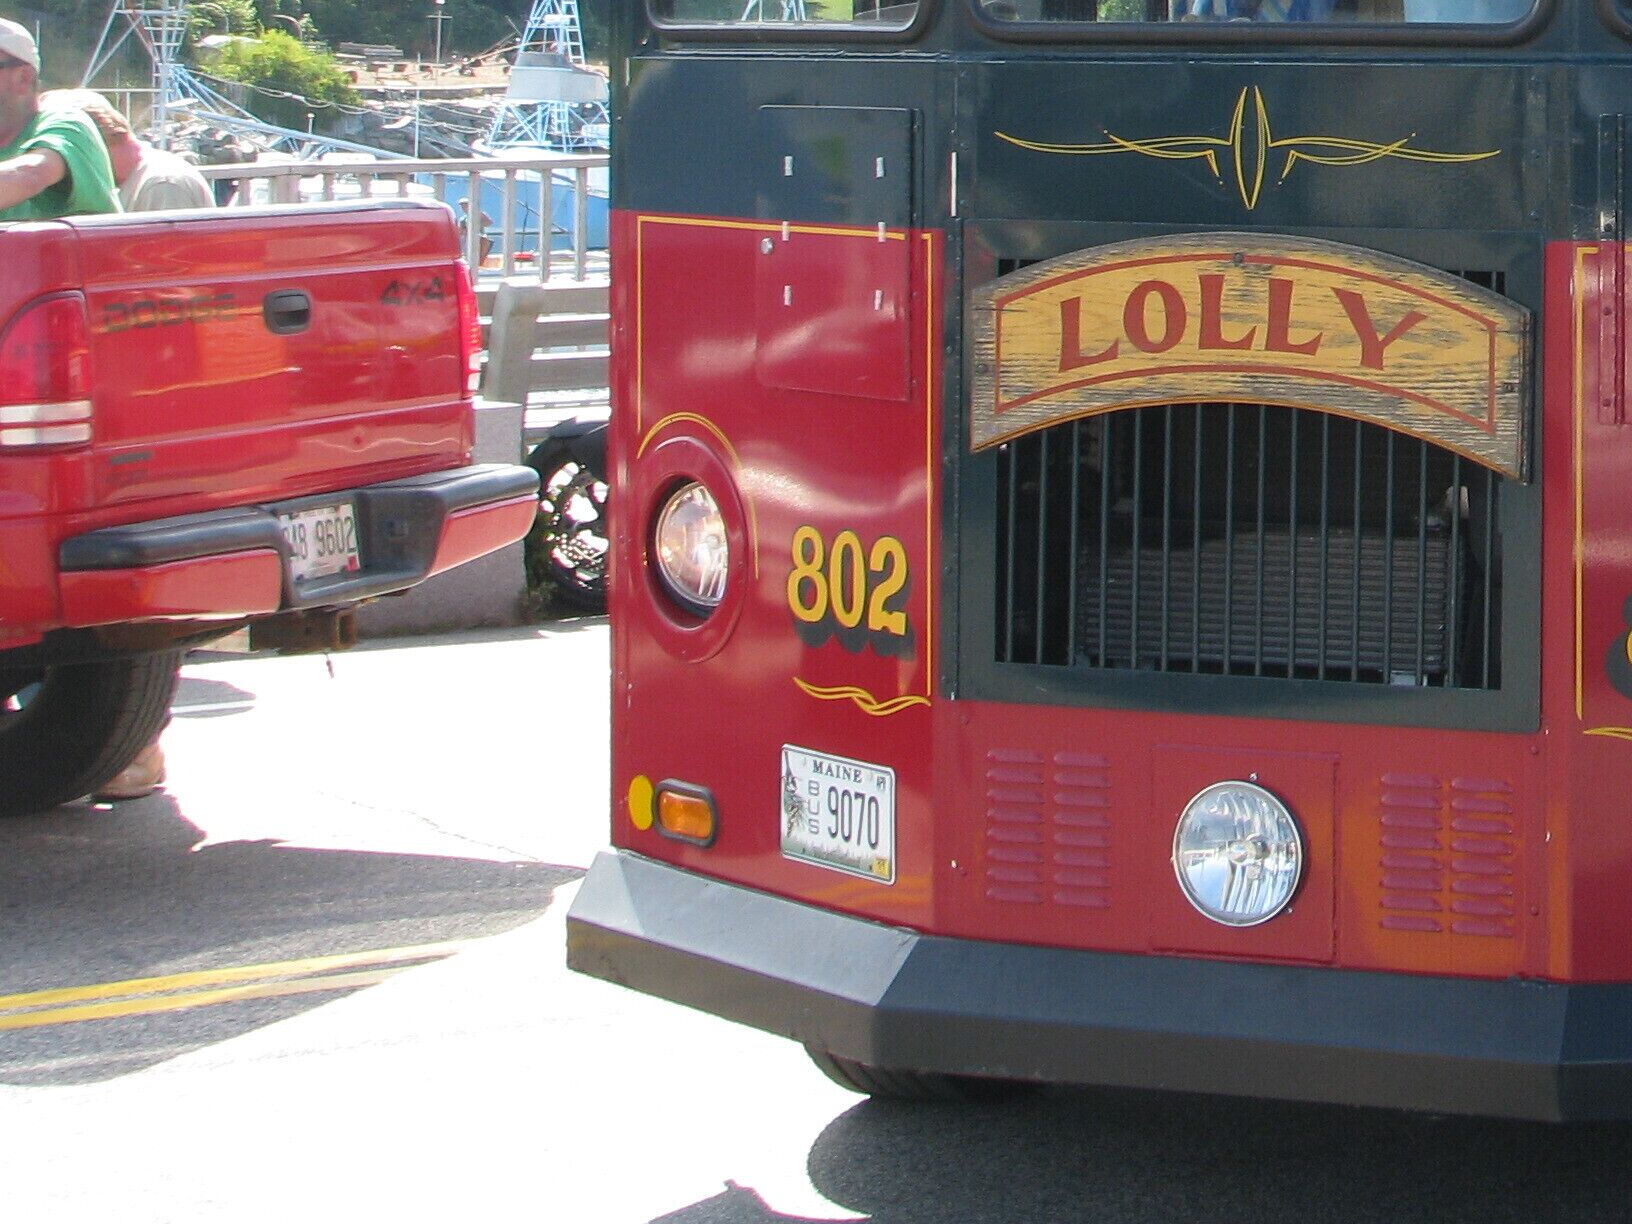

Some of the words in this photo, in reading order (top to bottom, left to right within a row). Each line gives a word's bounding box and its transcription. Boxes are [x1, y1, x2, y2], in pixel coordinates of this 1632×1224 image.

[1058, 274, 1427, 372] LOLLY
[786, 525, 909, 636] 802
[813, 759, 863, 784] MAINE
[807, 779, 820, 835] BUS
[827, 785, 880, 850] 9070
